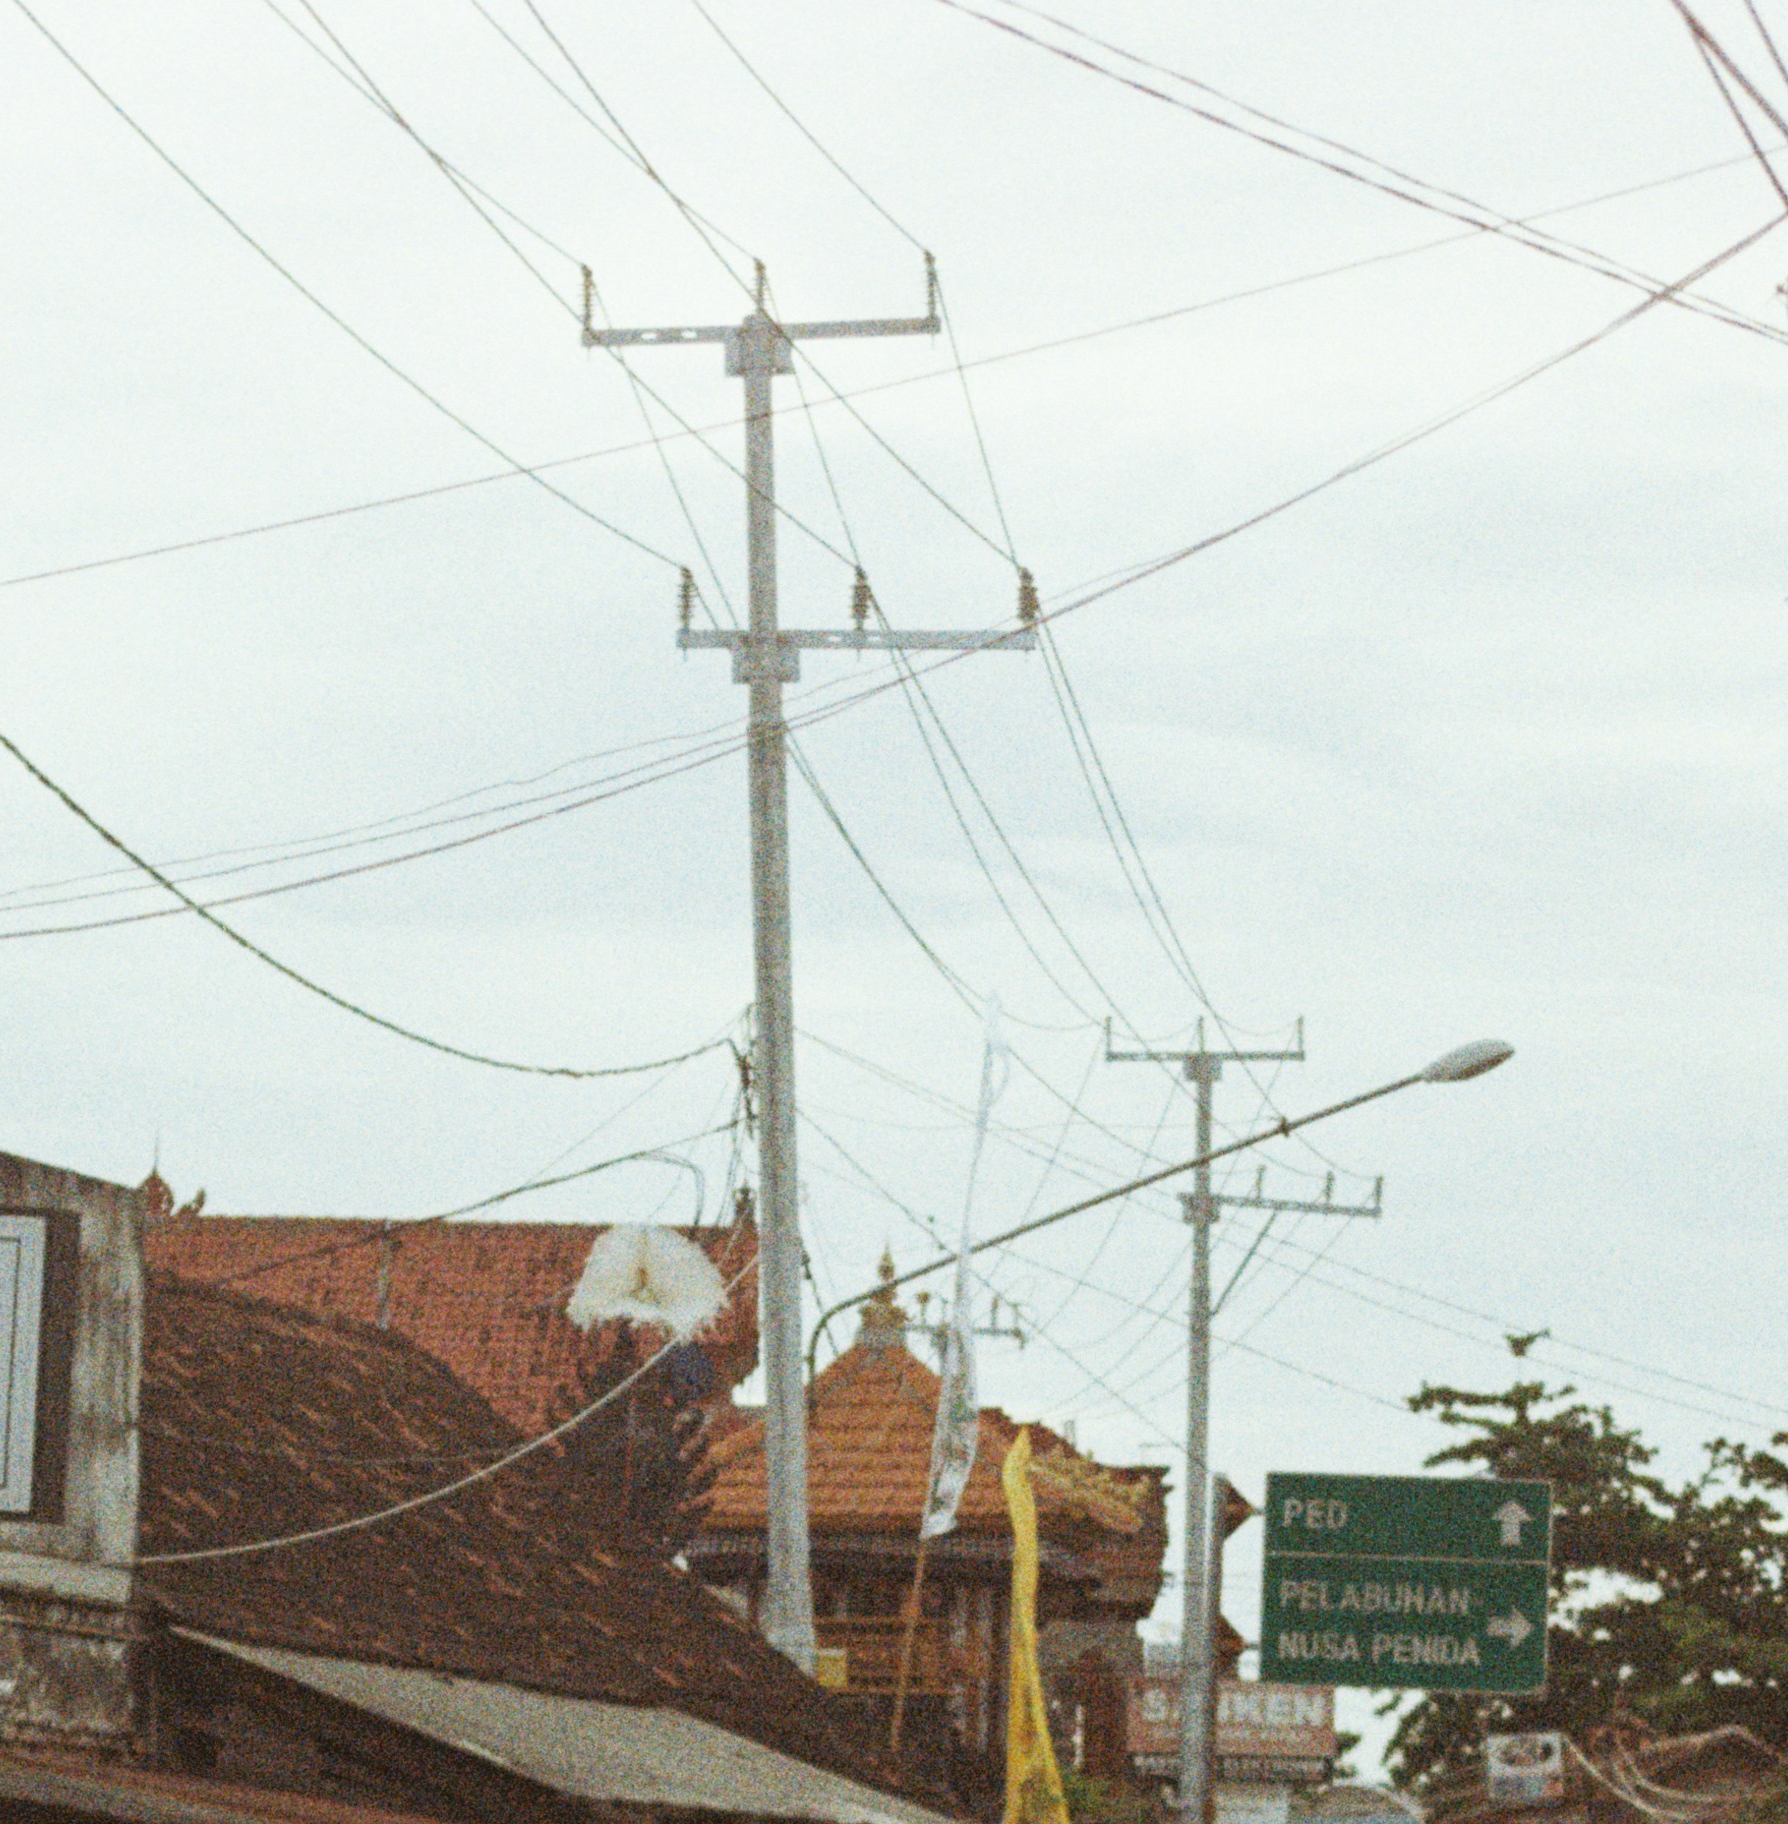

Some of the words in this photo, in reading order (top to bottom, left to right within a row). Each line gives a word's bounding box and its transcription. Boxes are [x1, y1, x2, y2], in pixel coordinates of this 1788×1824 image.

[1282, 1498, 1348, 1530] PED
[1279, 1579, 1471, 1615] PELABUHAN
[1277, 1631, 1360, 1662] NUSA
[1371, 1632, 1481, 1667] PENIDA
